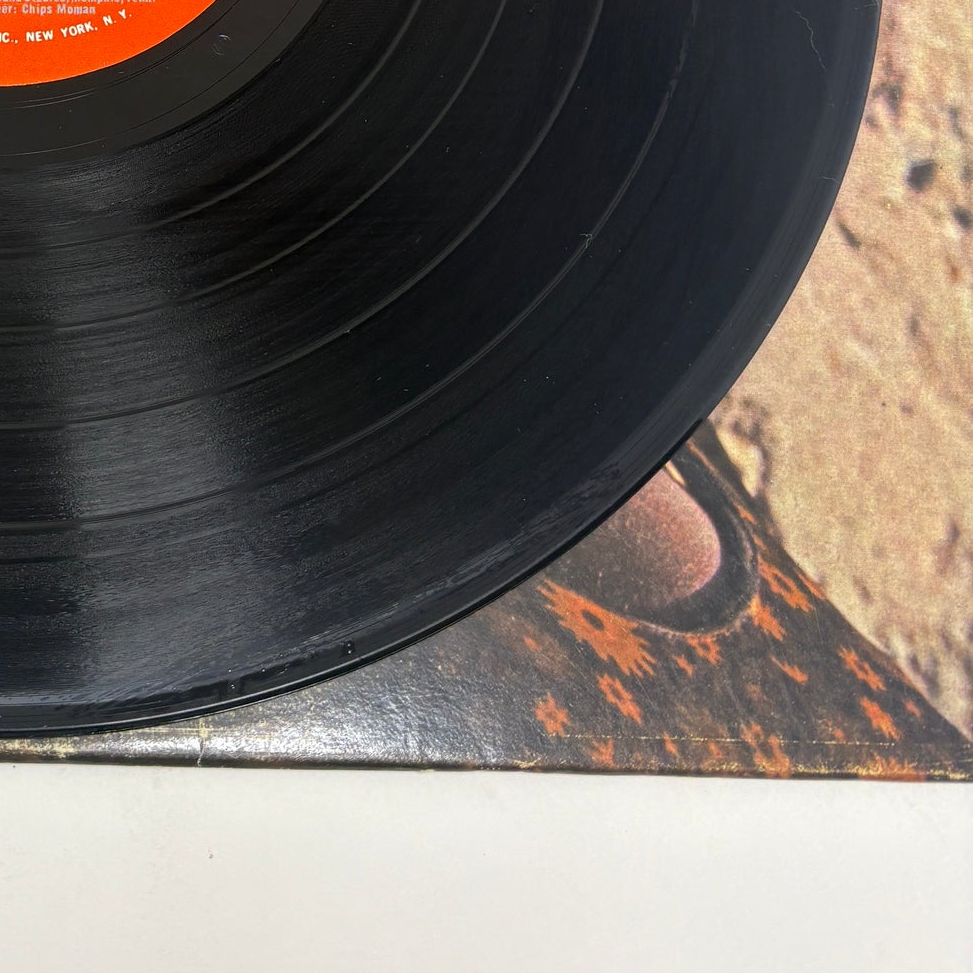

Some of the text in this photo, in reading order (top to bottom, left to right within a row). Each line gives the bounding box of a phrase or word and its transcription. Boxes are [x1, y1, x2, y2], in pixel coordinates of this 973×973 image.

[22, 4, 53, 16] Chips
[57, 5, 96, 15] Moman
[25, 30, 54, 42] NEW
[102, 15, 117, 27] N.
[118, 9, 132, 20] Y.
